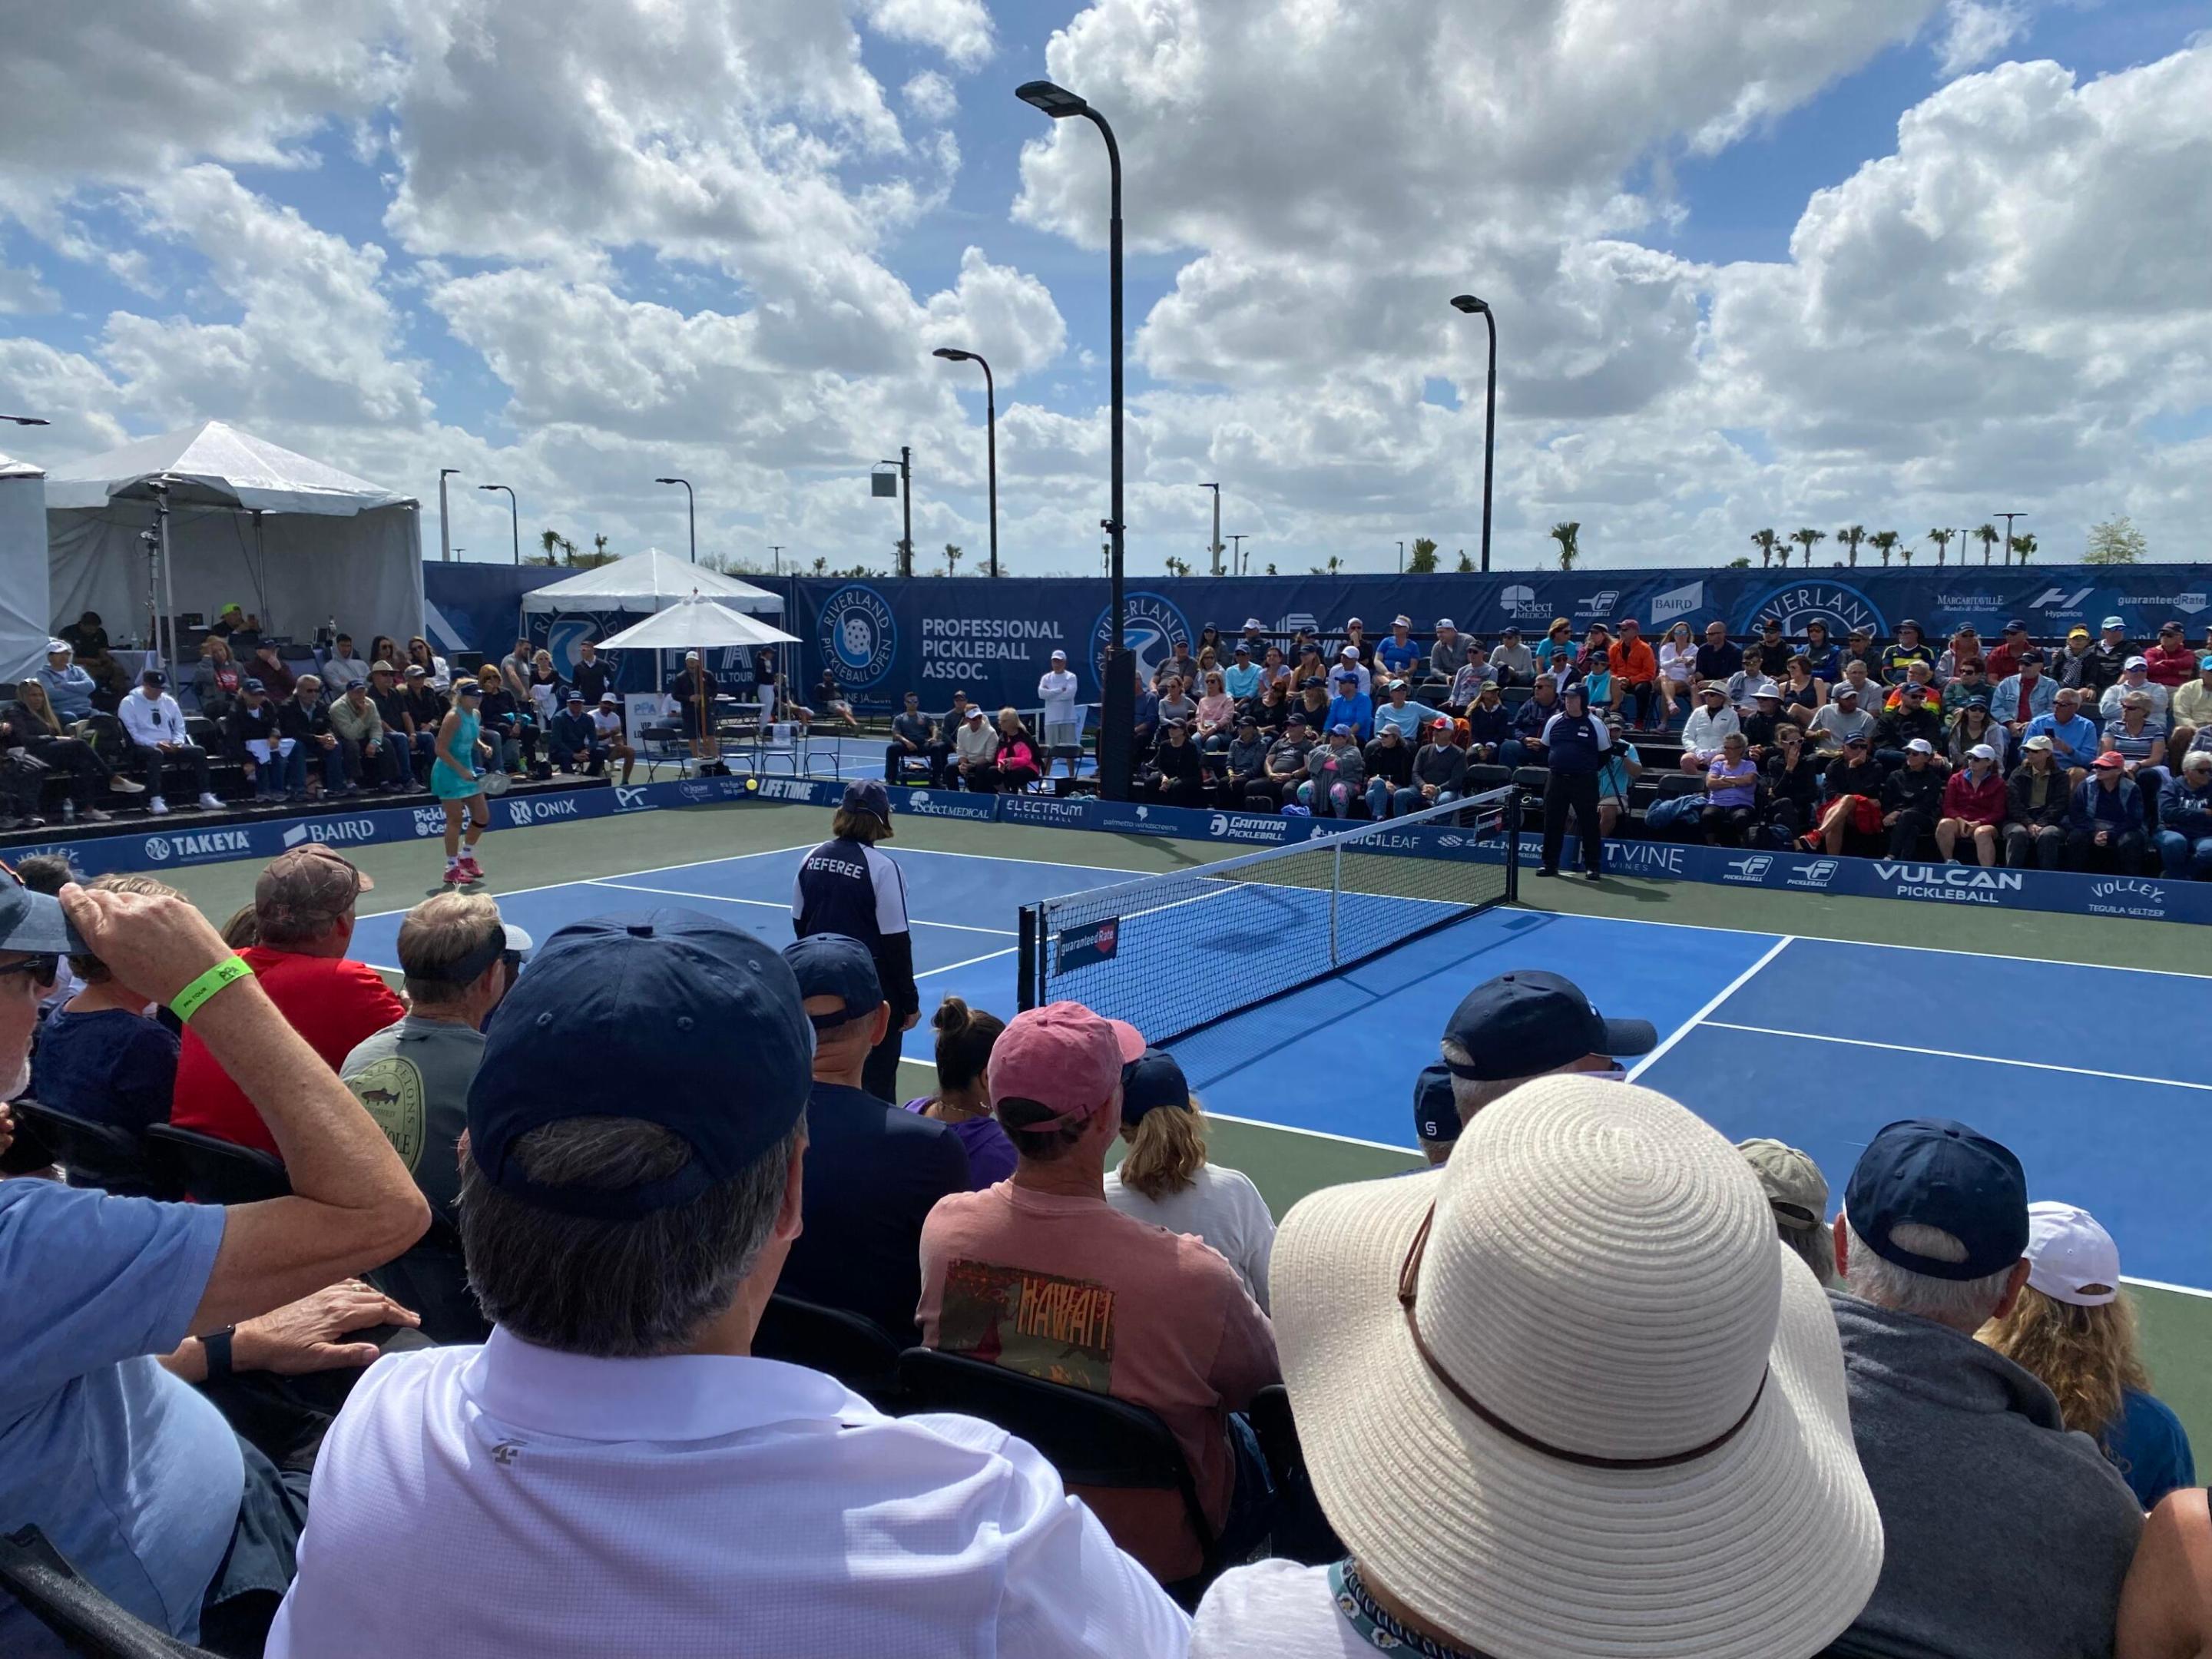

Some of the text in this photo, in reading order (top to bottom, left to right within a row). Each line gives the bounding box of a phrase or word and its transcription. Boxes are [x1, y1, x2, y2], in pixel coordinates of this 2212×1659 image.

[1518, 601, 1553, 612] Select
[1655, 599, 1693, 610] BAIRD
[1937, 594, 2004, 605] MARGARITAVILLE
[2118, 595, 2206, 606] guaranteed Rate
[823, 591, 889, 628] RIVERLAND
[1752, 588, 1876, 636] RIVERLAND
[922, 618, 1064, 639] PROFESSIONAL
[1098, 599, 1186, 642] RIRLAND
[821, 637, 892, 682] PICKLEBALL OPEN
[922, 640, 1030, 660] PICKLEBALL
[922, 661, 989, 680] ASSOC.
[535, 799, 578, 818] ONIX
[918, 800, 989, 819] Select MEDICAL
[1006, 800, 1083, 816] ELECTRUM
[1013, 813, 1072, 823] PICKLEBALL
[1103, 818, 1134, 827] palmetto
[1230, 816, 1287, 832] GAMMA
[309, 820, 375, 842] BAIRD
[171, 831, 250, 855] TAKEYA
[806, 856, 864, 879] REFEREE
[1609, 862, 1648, 872] WINES
[1724, 874, 1763, 882] PICKLEBALL
[1787, 878, 1828, 887] PICKLEBALL
[1873, 863, 2022, 891] VULCAN
[1896, 885, 1999, 903] PICKLEBALL
[2091, 879, 2166, 899] VOLLEY
[2088, 904, 2165, 917] TEQUILA SELTZER
[1061, 930, 1114, 956] guaranteed Rate
[1017, 1277, 1111, 1349] HAWAII
